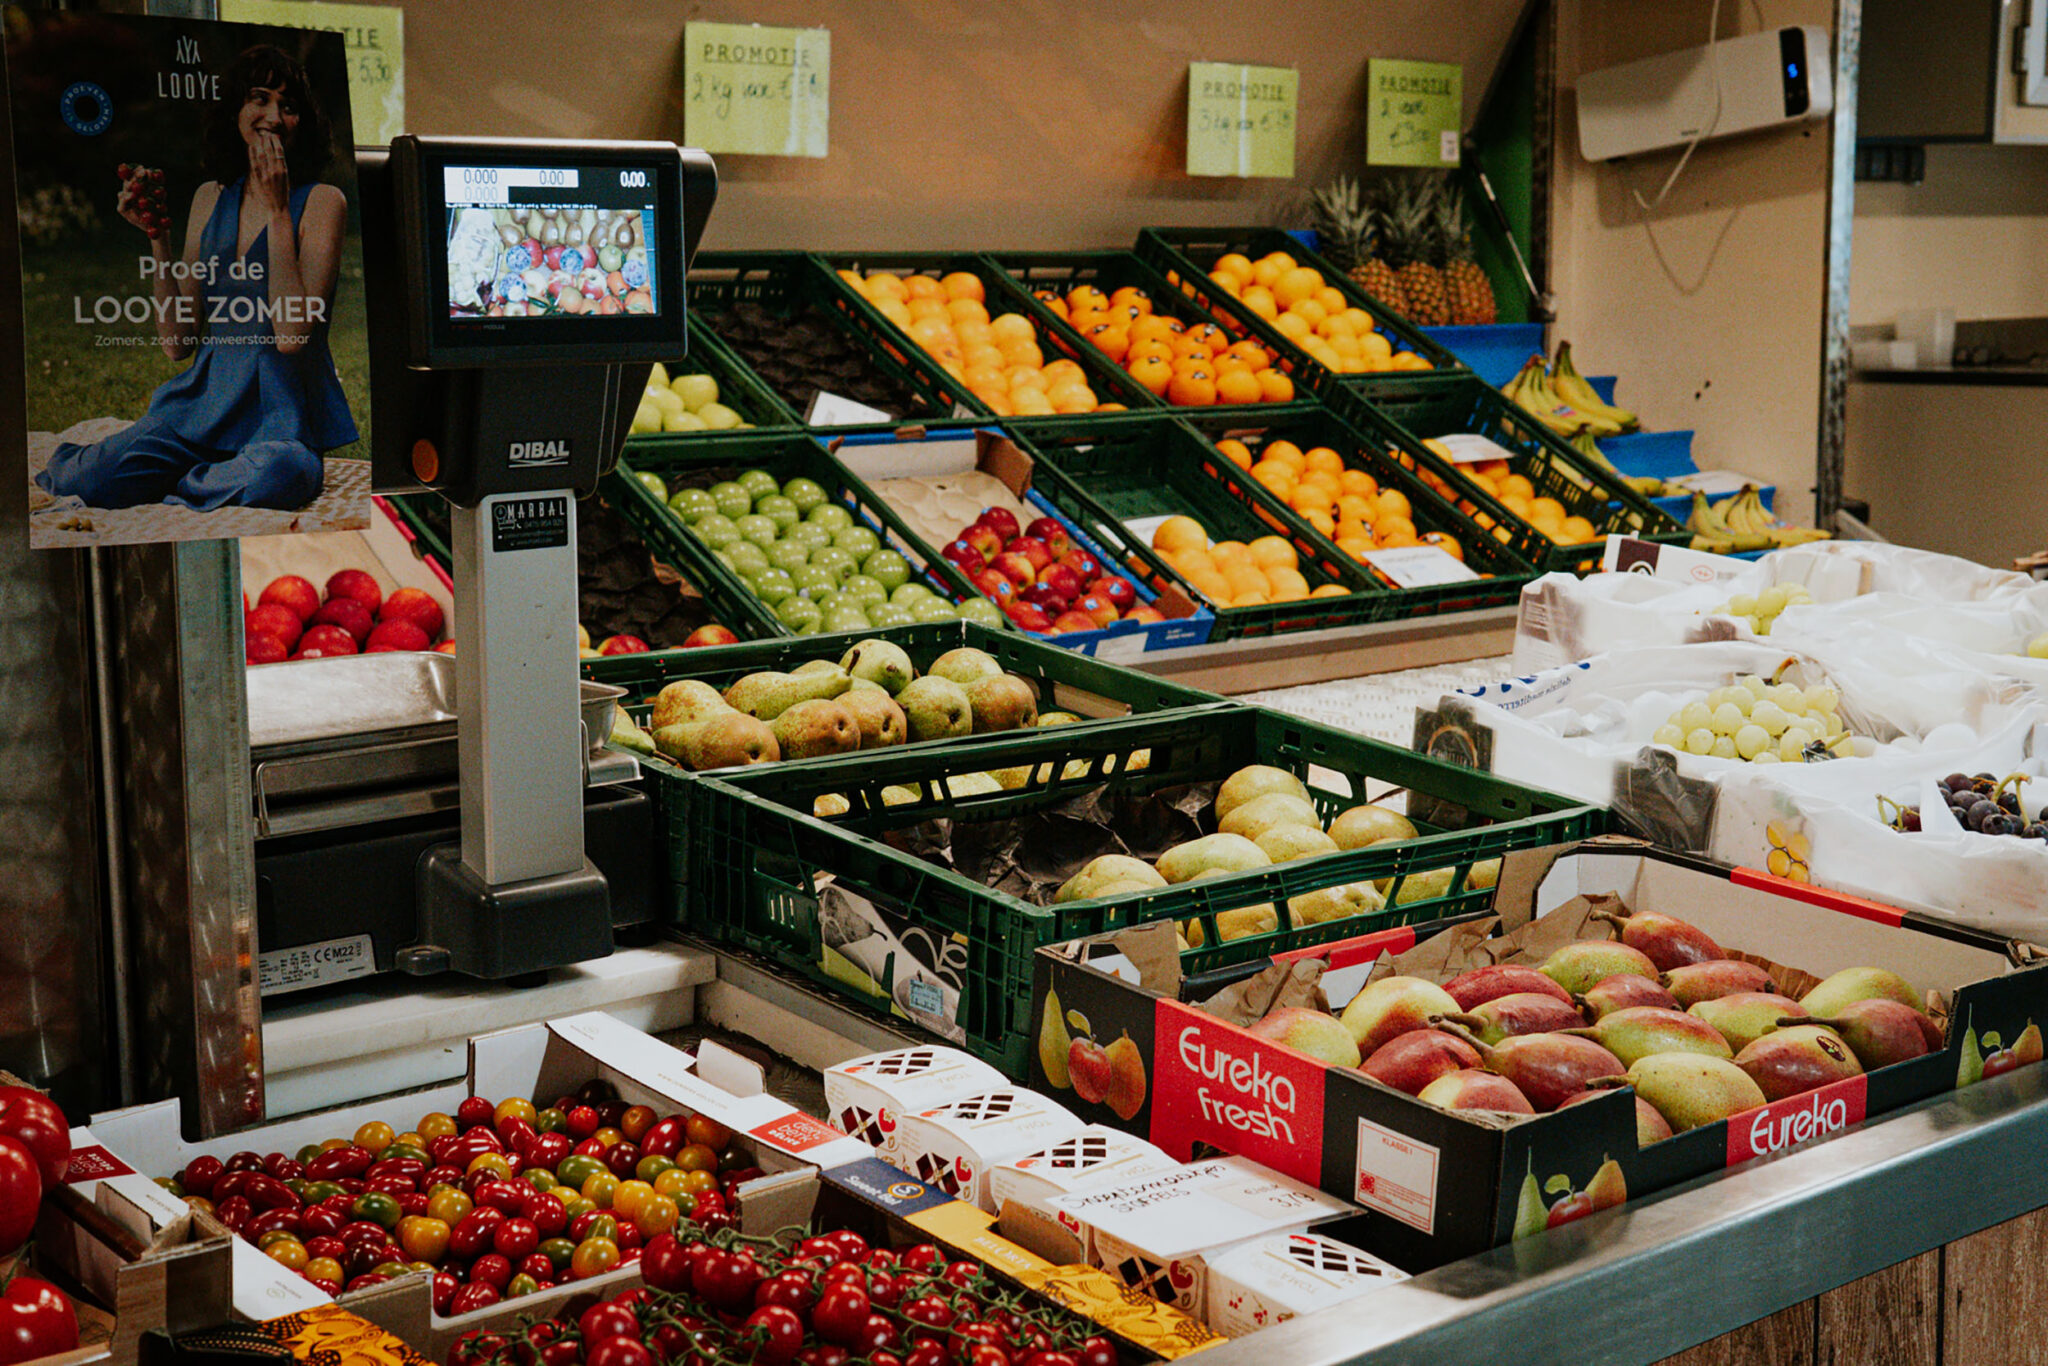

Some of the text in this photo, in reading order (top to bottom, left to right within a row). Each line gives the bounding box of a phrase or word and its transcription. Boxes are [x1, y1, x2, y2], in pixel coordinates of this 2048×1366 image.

[703, 43, 811, 68] PROMOTIE
[157, 71, 221, 101] LOOYE
[693, 72, 704, 102] 2
[1203, 81, 1284, 101] PROMOTIE
[1380, 75, 1451, 96] PROMOTIE
[138, 255, 265, 286] Proef de
[73, 295, 327, 324] LOOYE ZOMER
[94, 334, 311, 348] Zomers, zoet en onweerstaanbaar
[509, 440, 570, 461] DIBAL
[507, 500, 566, 520] MARBAL
[332, 945, 355, 959] M22
[1178, 1026, 1296, 1114] Eureka
[1197, 1087, 1295, 1145] fresh
[1750, 1093, 1847, 1155] Eureka
